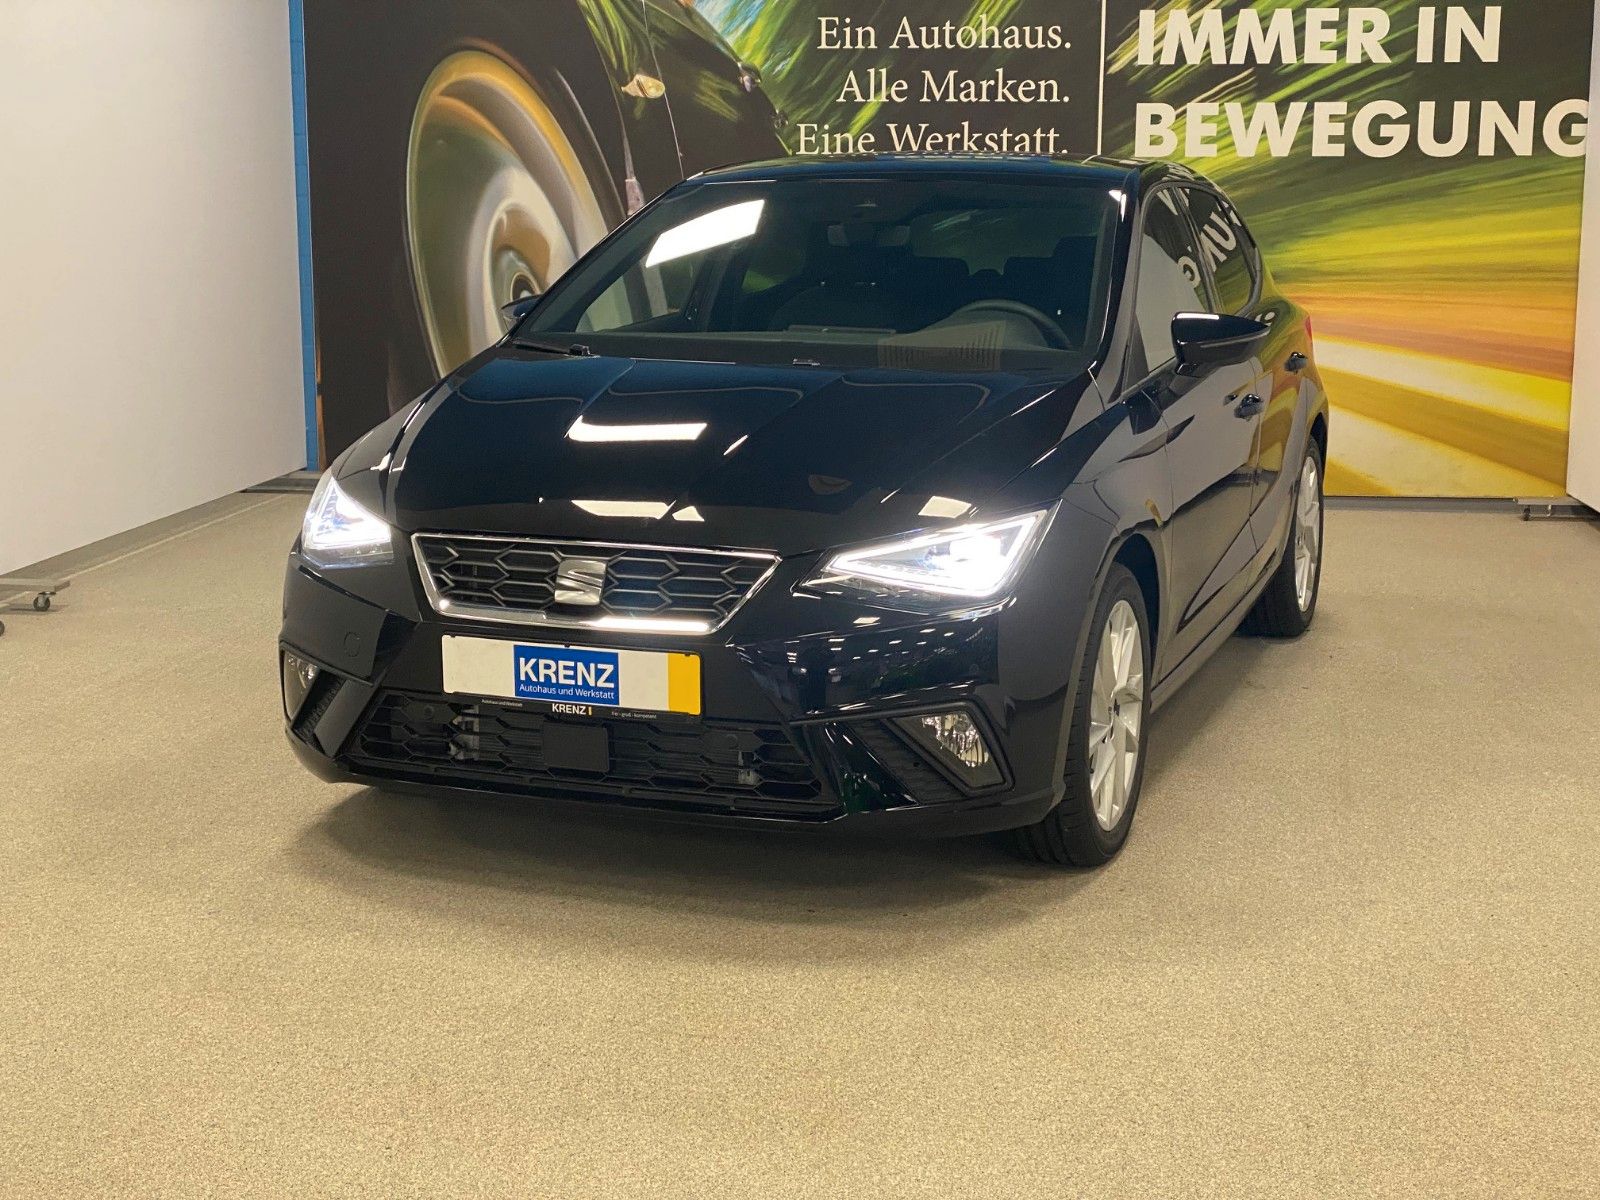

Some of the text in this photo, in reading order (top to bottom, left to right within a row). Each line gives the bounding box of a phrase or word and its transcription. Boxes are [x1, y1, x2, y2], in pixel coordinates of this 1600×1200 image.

[817, 14, 1072, 49] Ein Autohaus.
[1137, 6, 1500, 65] IMMER IN
[836, 68, 1070, 102] Alle Marken.
[796, 121, 1068, 155] Eine Werkstatt.
[1134, 98, 1589, 158] BEWEGUNG
[519, 657, 615, 688] KRENZ
[519, 684, 615, 700] Autohaus und Werkstatt
[552, 703, 586, 715] KRENZ
